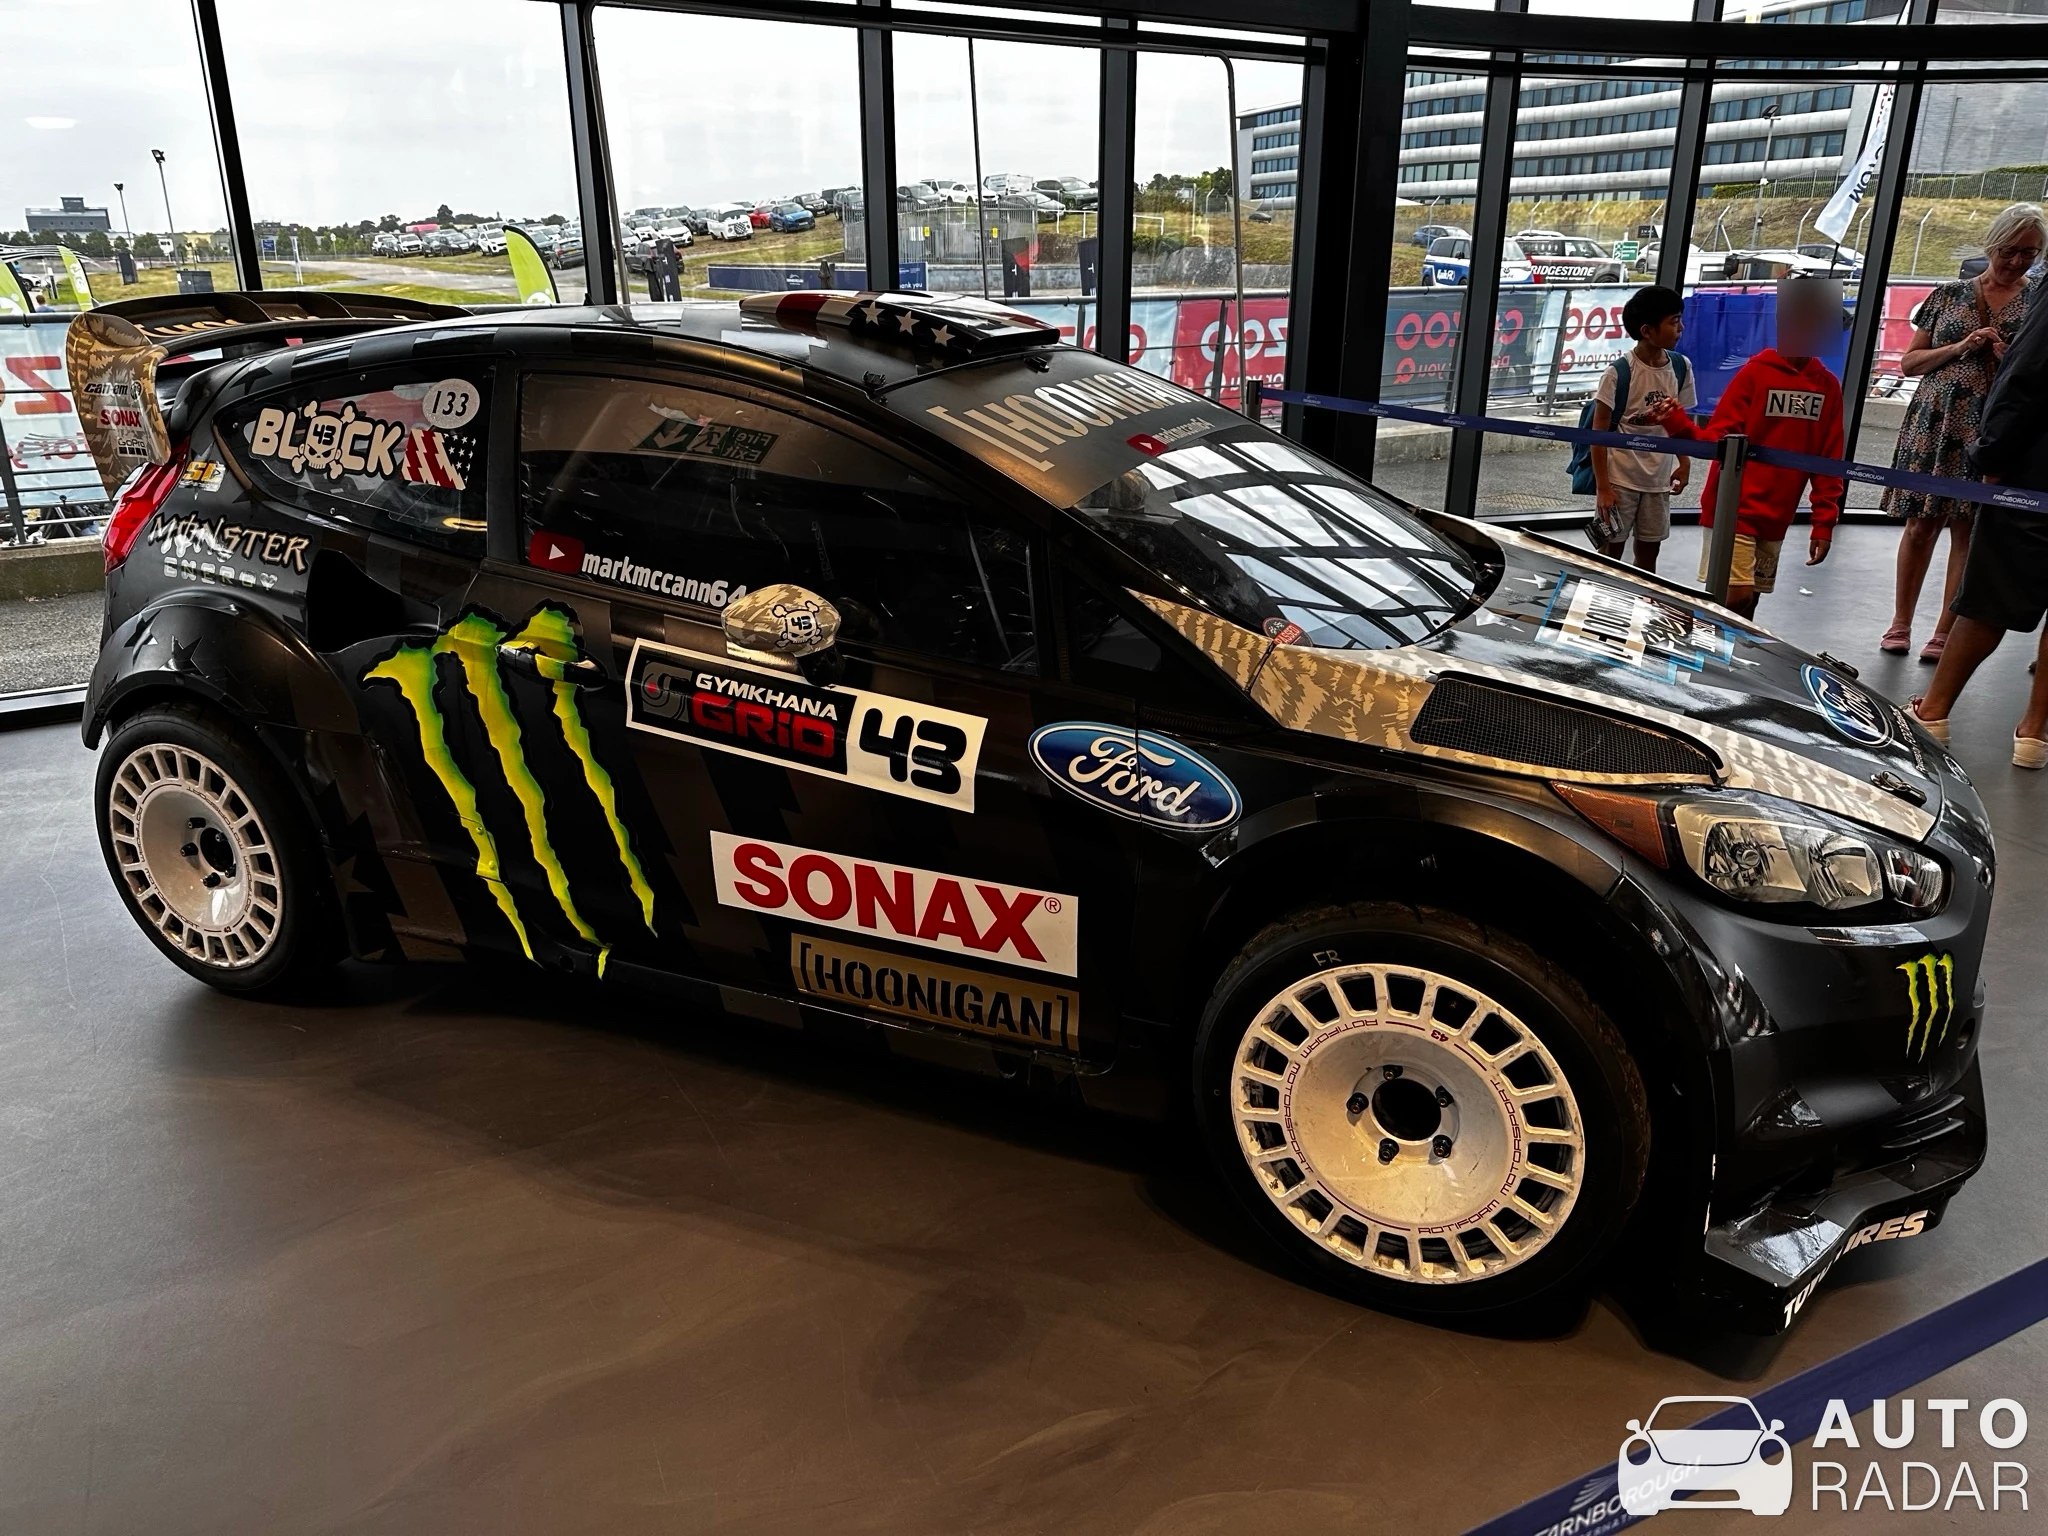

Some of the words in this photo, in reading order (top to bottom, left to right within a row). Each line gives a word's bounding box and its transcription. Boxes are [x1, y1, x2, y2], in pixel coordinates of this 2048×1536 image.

[1531, 265, 1596, 276] RIDGESTONE
[100, 409, 142, 427] SONAX
[432, 391, 469, 416] 133
[1769, 392, 1822, 417] NIKE
[312, 423, 337, 445] 43
[926, 372, 1221, 472] [HOONIGAN
[118, 438, 146, 447] GoPro
[1846, 469, 1885, 481] FARNBOROUGH
[1993, 494, 2040, 507] FARNBOROUGH
[148, 512, 311, 574] MONSTER
[582, 553, 747, 607] markmccann64
[791, 615, 812, 631] 43
[695, 673, 838, 722] GYMKHANA
[1817, 673, 1880, 733] Ford
[859, 706, 968, 796] 43
[1068, 736, 1203, 819] Ford
[1314, 950, 1342, 967] FR
[1300, 1018, 1378, 1058] ROTIFORM
[1430, 1029, 1449, 1043] 43
[1282, 1062, 1314, 1174] MOTORSPORT
[1418, 1199, 1500, 1234] ROTIFORM
[1490, 1079, 1522, 1195] MOTORSPORT
[1784, 1261, 1833, 1328] TO
